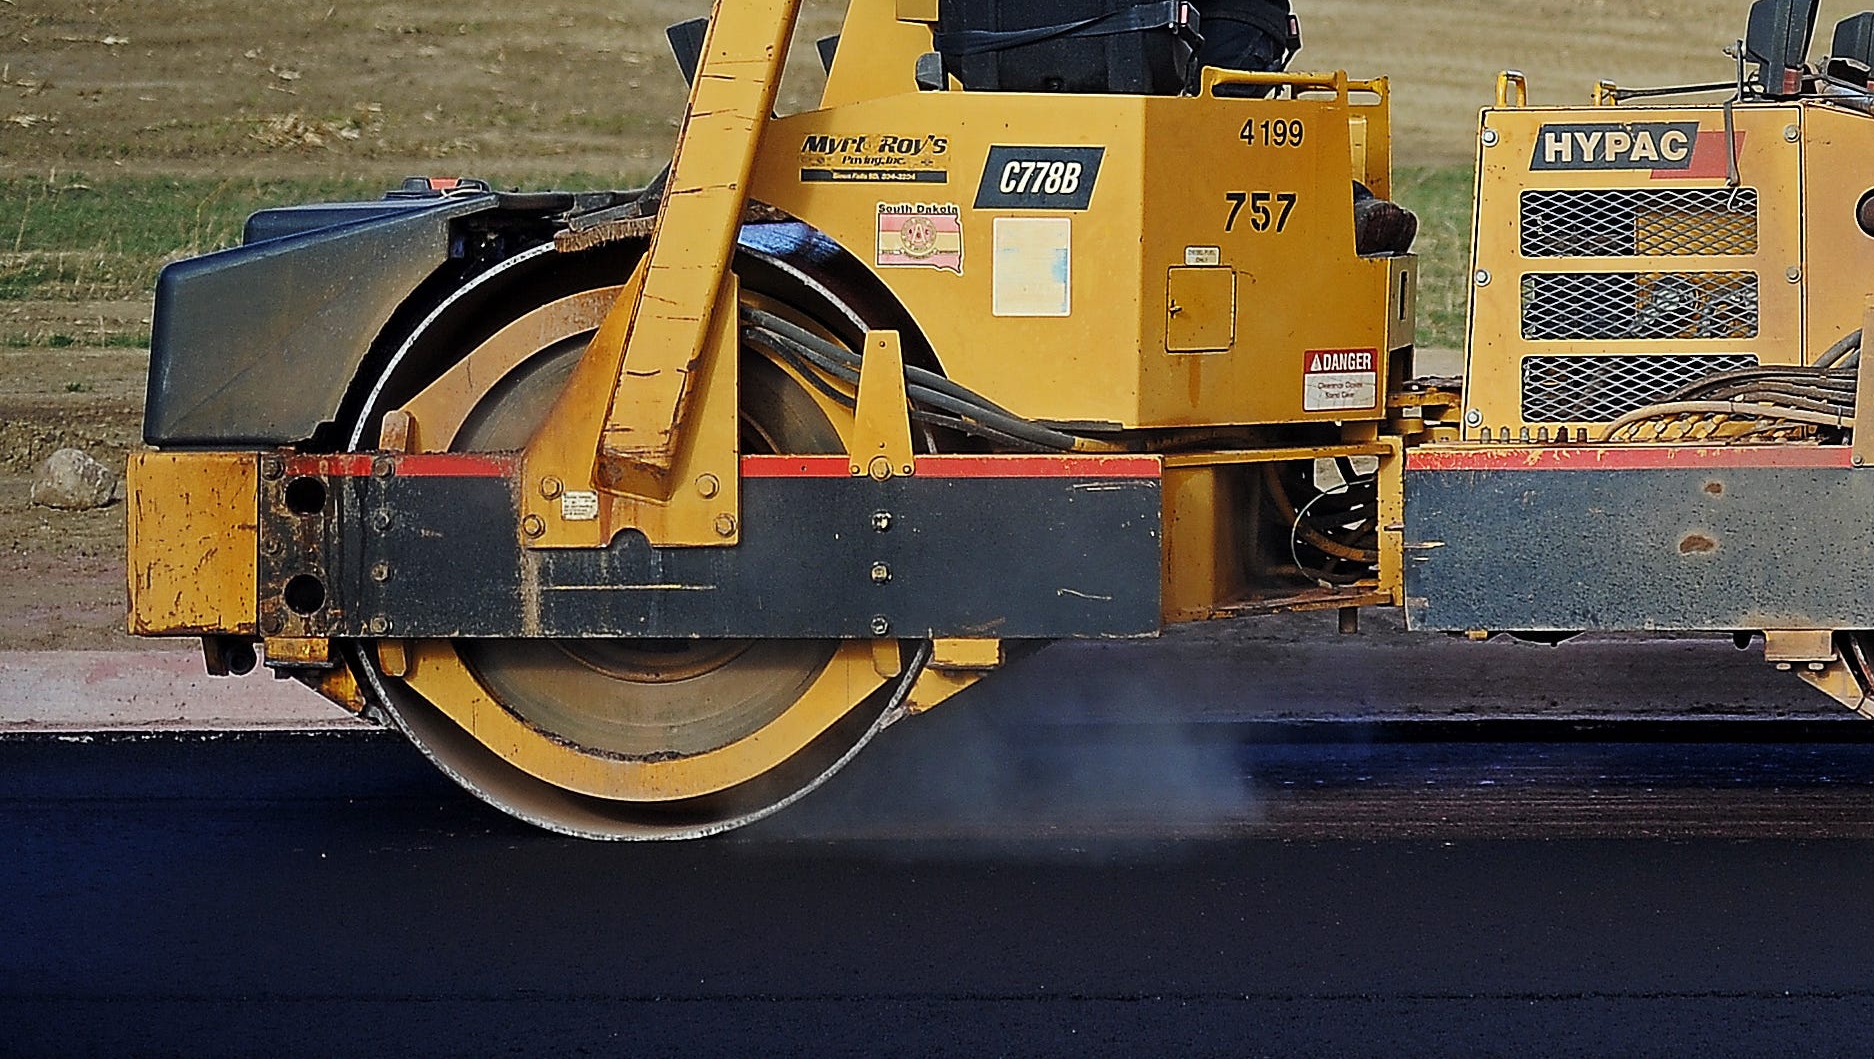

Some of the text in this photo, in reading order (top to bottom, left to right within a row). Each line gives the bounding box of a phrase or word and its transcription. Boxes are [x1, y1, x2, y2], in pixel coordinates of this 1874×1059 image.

[878, 134, 949, 156] Roy's
[1239, 119, 1304, 147] 4199
[1544, 130, 1688, 163] HYPAC
[1000, 160, 1082, 194] C778B
[878, 204, 958, 214] South Dakota
[1224, 192, 1297, 233] 757
[1323, 352, 1372, 371] DANGER
